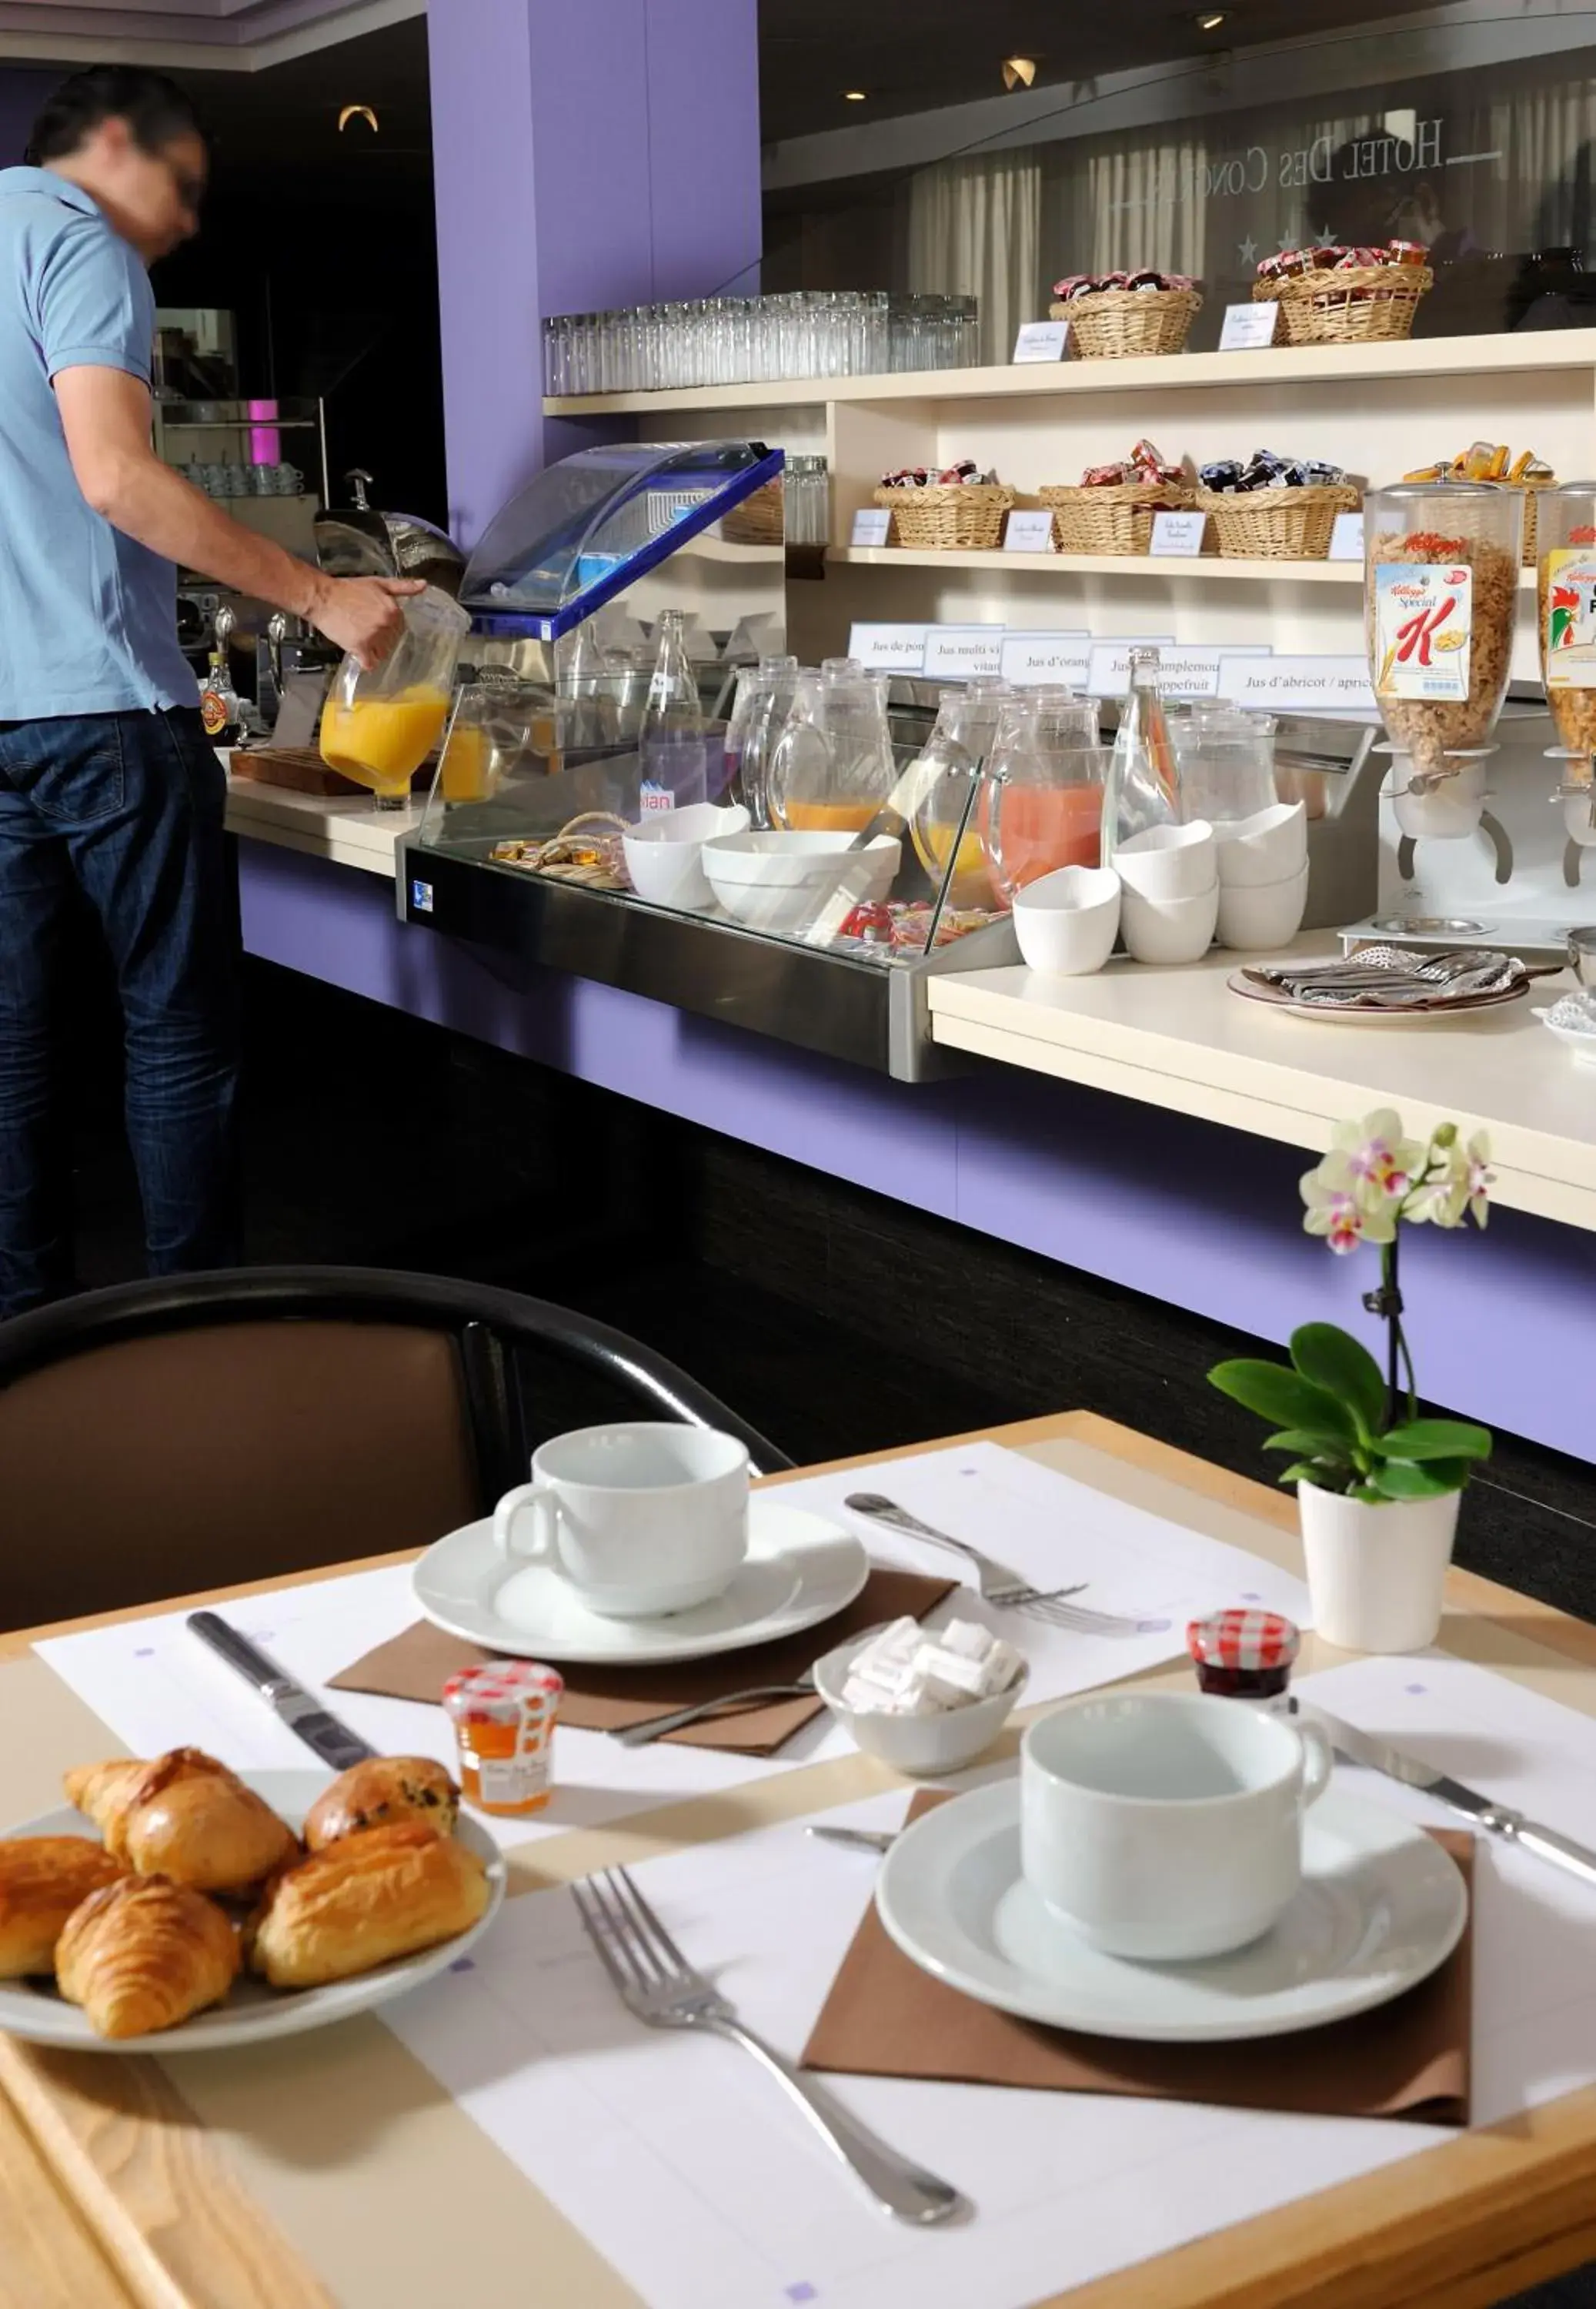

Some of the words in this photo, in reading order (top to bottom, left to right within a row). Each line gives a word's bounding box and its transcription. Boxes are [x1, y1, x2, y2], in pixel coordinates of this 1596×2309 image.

[1397, 596, 1457, 667] K
[871, 641, 889, 651] Jus
[890, 641, 903, 651] de
[937, 645, 954, 655] Jus
[957, 644, 986, 654] multi
[1027, 657, 1044, 667] Jus
[1157, 660, 1220, 674] amplemou
[1246, 677, 1266, 687] Jus
[1269, 677, 1325, 687] d'abricot
